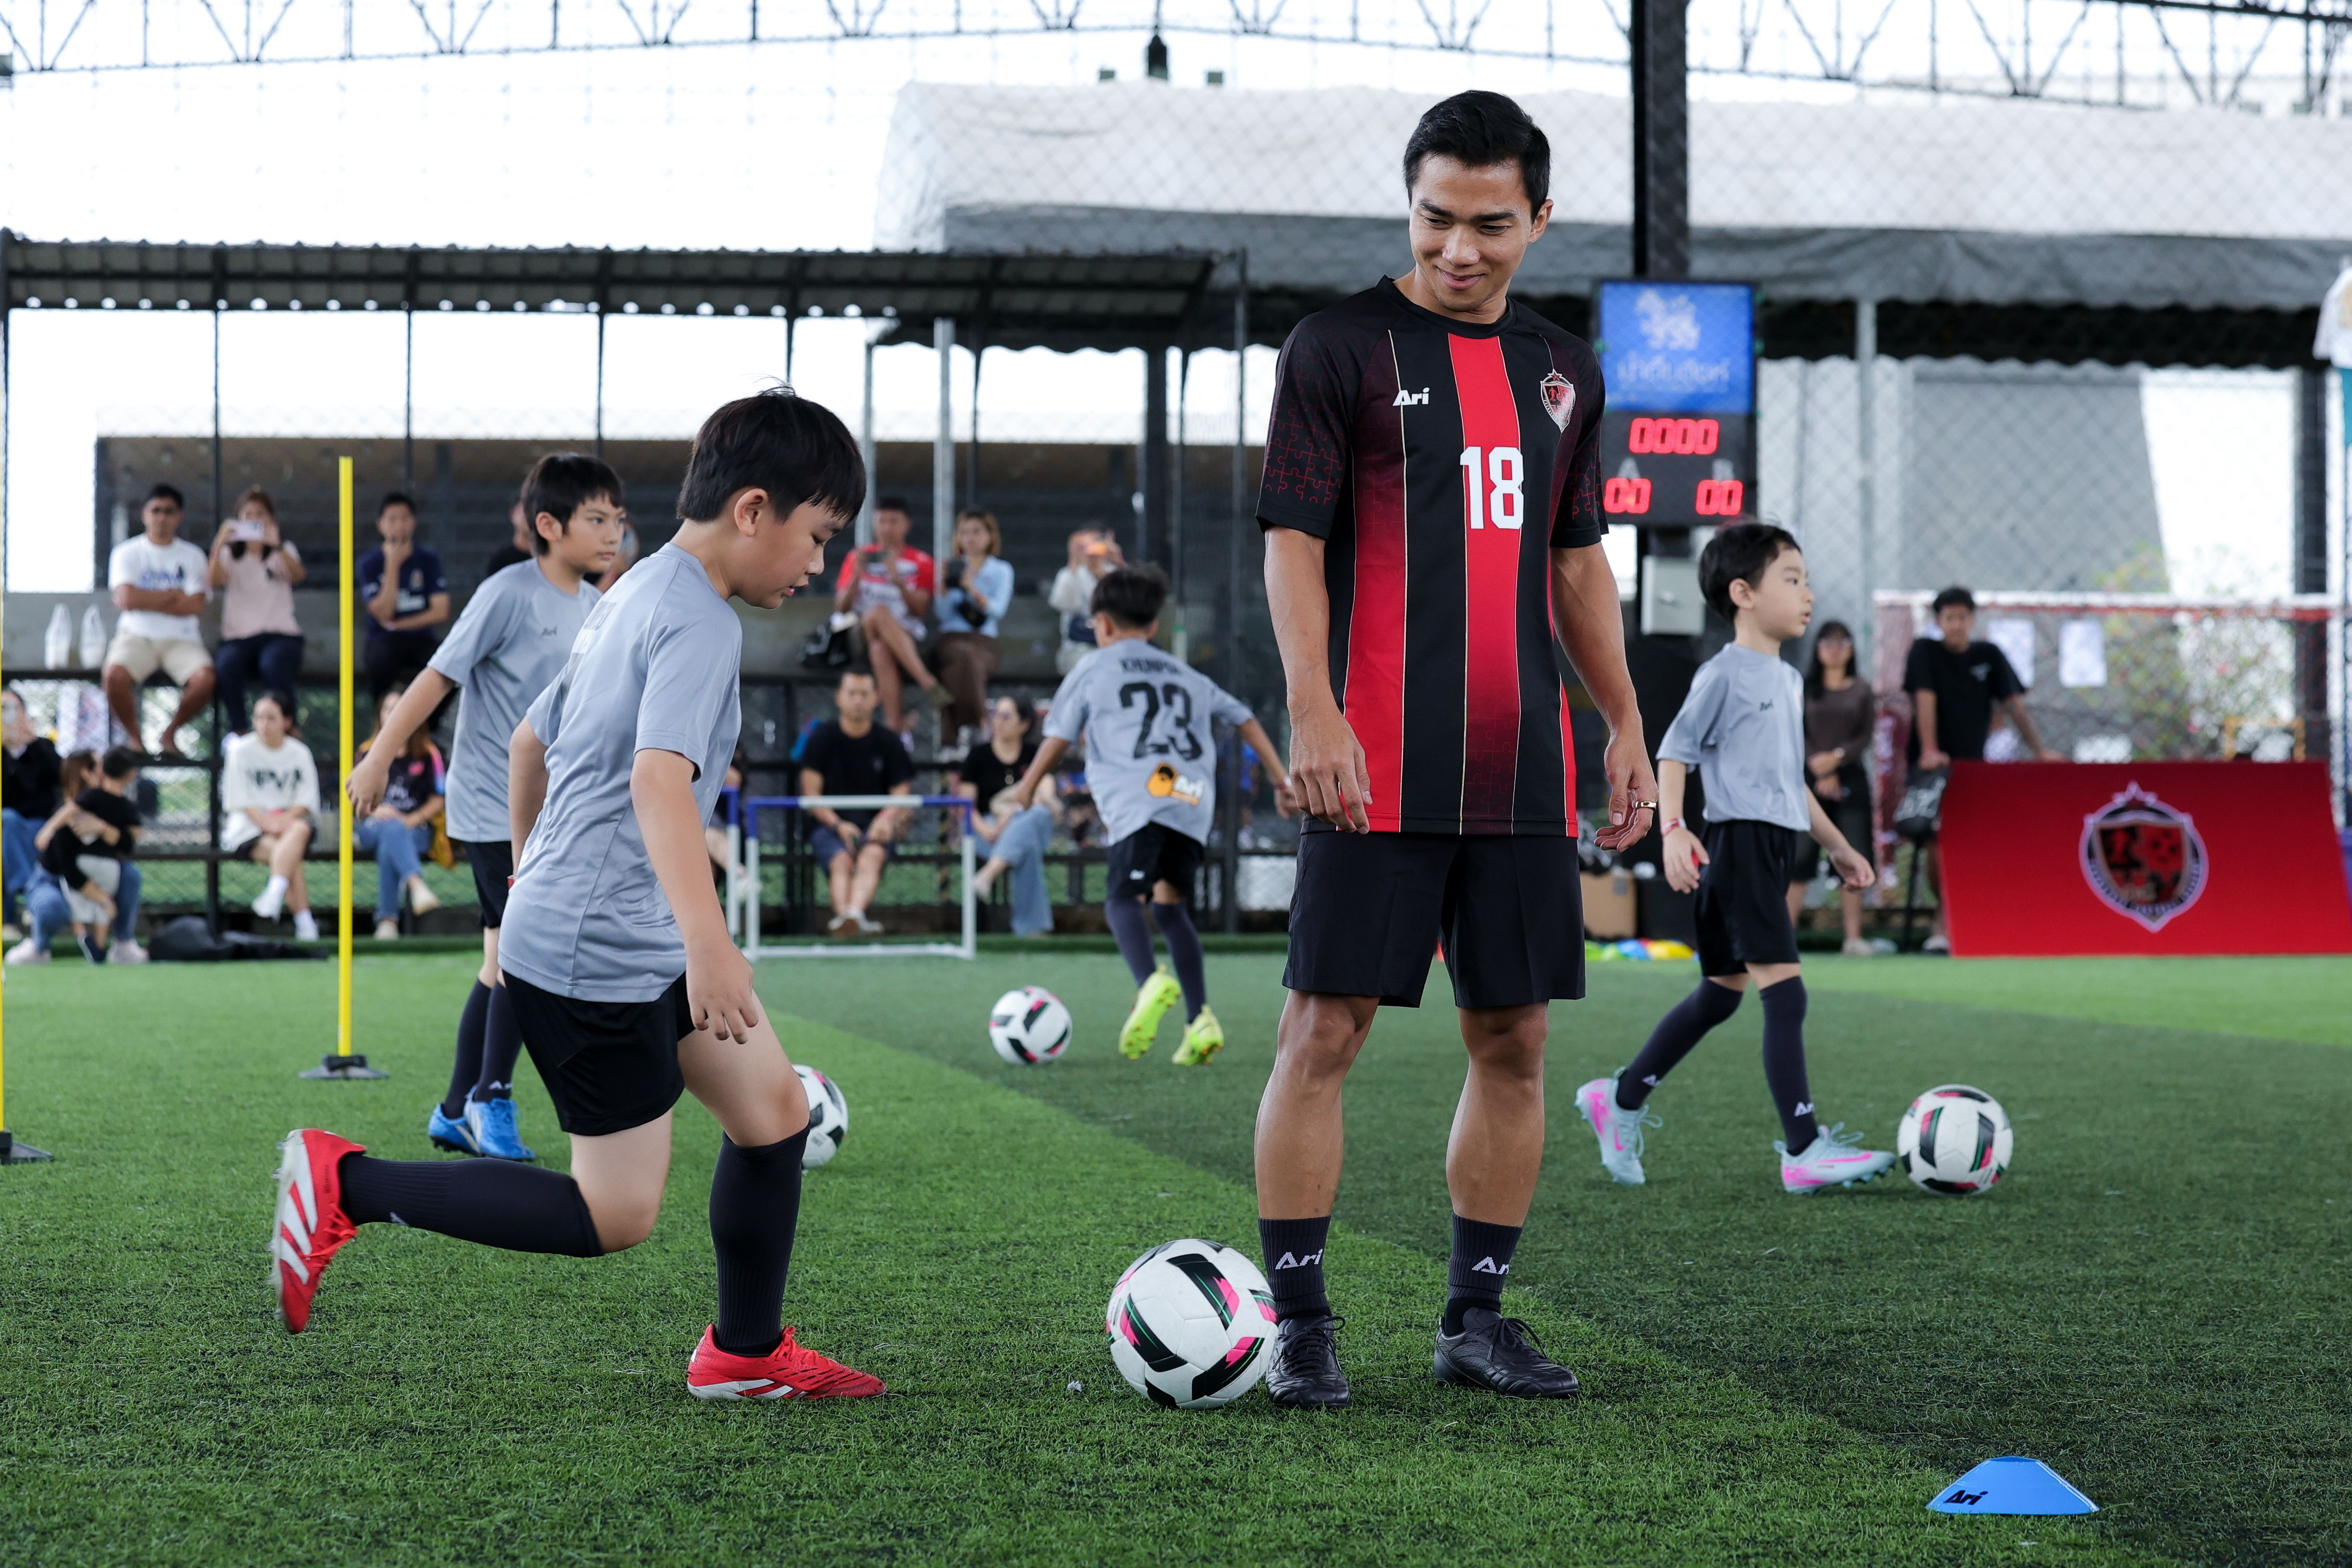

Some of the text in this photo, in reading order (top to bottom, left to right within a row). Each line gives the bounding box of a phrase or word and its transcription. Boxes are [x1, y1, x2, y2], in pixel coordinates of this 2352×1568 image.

[1392, 387, 1430, 406] Ari
[1459, 446, 1525, 529] 18
[1604, 477, 1652, 514] 00
[1696, 480, 1743, 515] 00
[1119, 680, 1203, 761] 23
[1275, 1248, 1323, 1270] Ari
[1943, 1490, 1989, 1506] Ari
